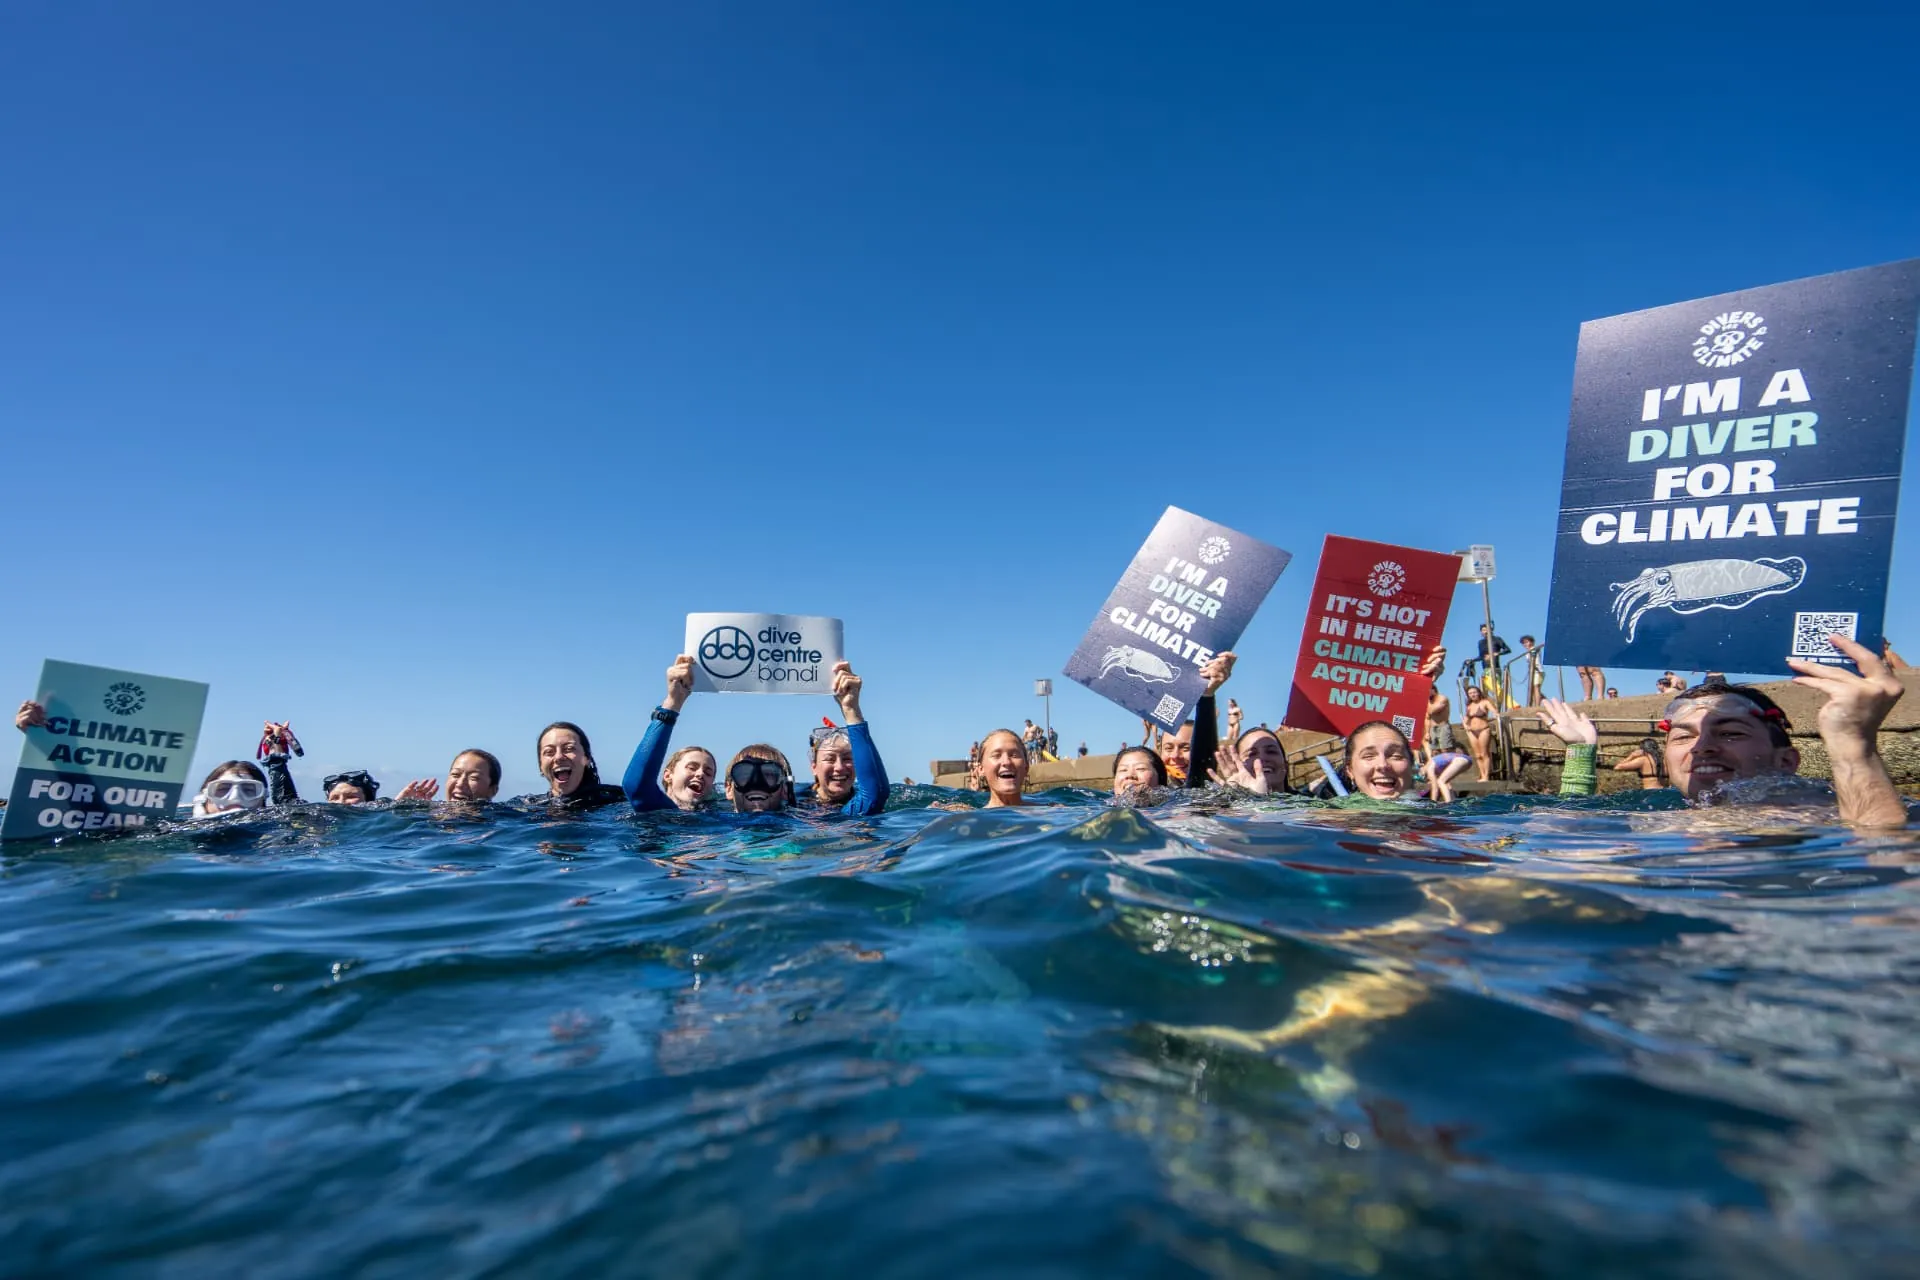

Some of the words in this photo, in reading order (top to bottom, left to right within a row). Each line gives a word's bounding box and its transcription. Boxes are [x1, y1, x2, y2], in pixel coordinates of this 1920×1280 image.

[1699, 311, 1765, 336] DIVERS
[1692, 337, 1764, 368] CLIMATE
[1641, 377, 1741, 421] I'M
[1758, 368, 1812, 407] A
[1627, 411, 1819, 463] DIVER
[1653, 459, 1777, 501] FOR
[1580, 496, 1861, 546] CLIMATE
[1164, 556, 1208, 586] I'M
[1206, 576, 1229, 598] A
[1374, 561, 1405, 577] DIVERS
[1149, 574, 1223, 619] DIVER
[1367, 578, 1402, 597] CLIMATE
[1147, 598, 1197, 634] FOR
[1325, 594, 1373, 618] IT'S
[1378, 603, 1431, 628] HOT
[758, 627, 802, 645] dive
[1109, 606, 1214, 668] CLIMATE
[1319, 616, 1348, 636] IN
[1354, 622, 1422, 650] HERE.
[757, 647, 823, 663] centre
[1313, 639, 1421, 673] CLIMATE
[758, 664, 818, 682] bondi
[1311, 662, 1405, 693] ACTION
[1328, 687, 1389, 713] NOW
[46, 716, 185, 750] CLIMATE
[47, 743, 168, 774] ACTION
[28, 779, 95, 803] FOR
[103, 786, 168, 809] OUR
[37, 808, 147, 830] OCEAN
